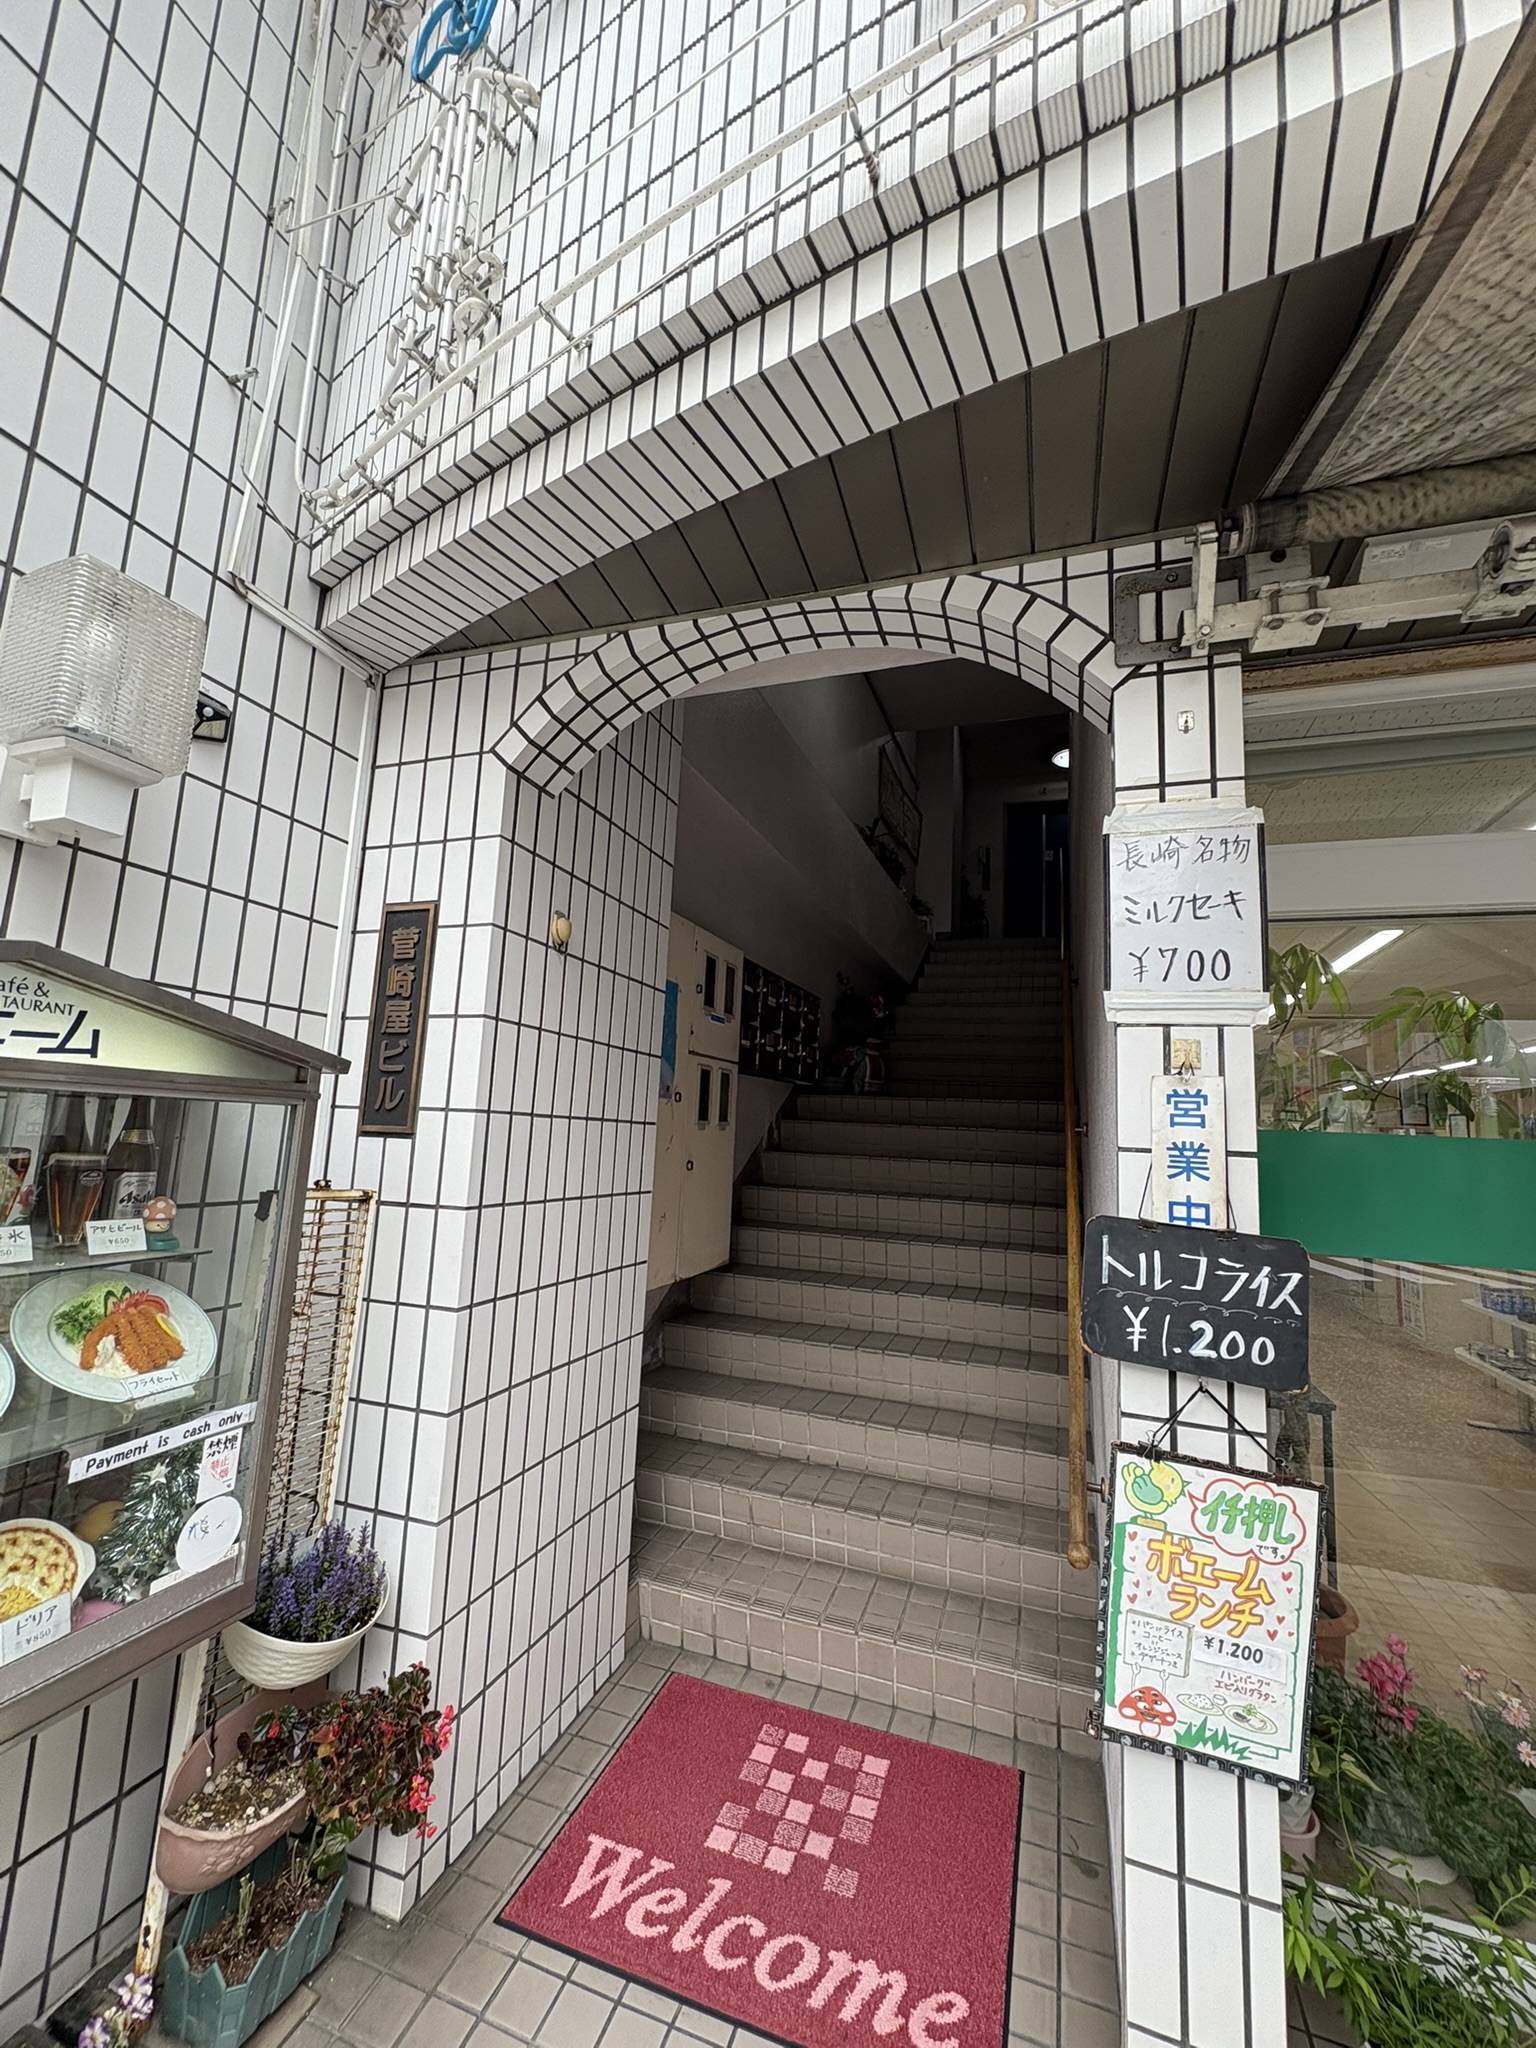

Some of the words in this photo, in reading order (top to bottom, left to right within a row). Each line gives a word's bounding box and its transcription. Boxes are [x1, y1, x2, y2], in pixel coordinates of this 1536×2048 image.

[1117, 833, 1251, 871] 長崎名物
[1122, 891, 1247, 925] ミルクセーキ
[1129, 946, 1232, 983] ¥700
[33, 981, 50, 998] &
[1166, 1088, 1211, 1227] 営業中
[90, 1223, 142, 1234] アサヒビール
[1101, 1235, 1303, 1316] トルコライス
[85, 1440, 149, 1473] Payment
[158, 1435, 170, 1448] is
[183, 1421, 211, 1440] cash
[205, 1432, 239, 1459] 禁煙
[1201, 1490, 1296, 1544] イチ押し
[1147, 1531, 1275, 1606] ボエーム
[16, 1604, 58, 1636] ドリア
[1167, 1582, 1265, 1639] ランチ
[25, 1628, 52, 1645] ¥850
[560, 1833, 970, 2048] Welcome
